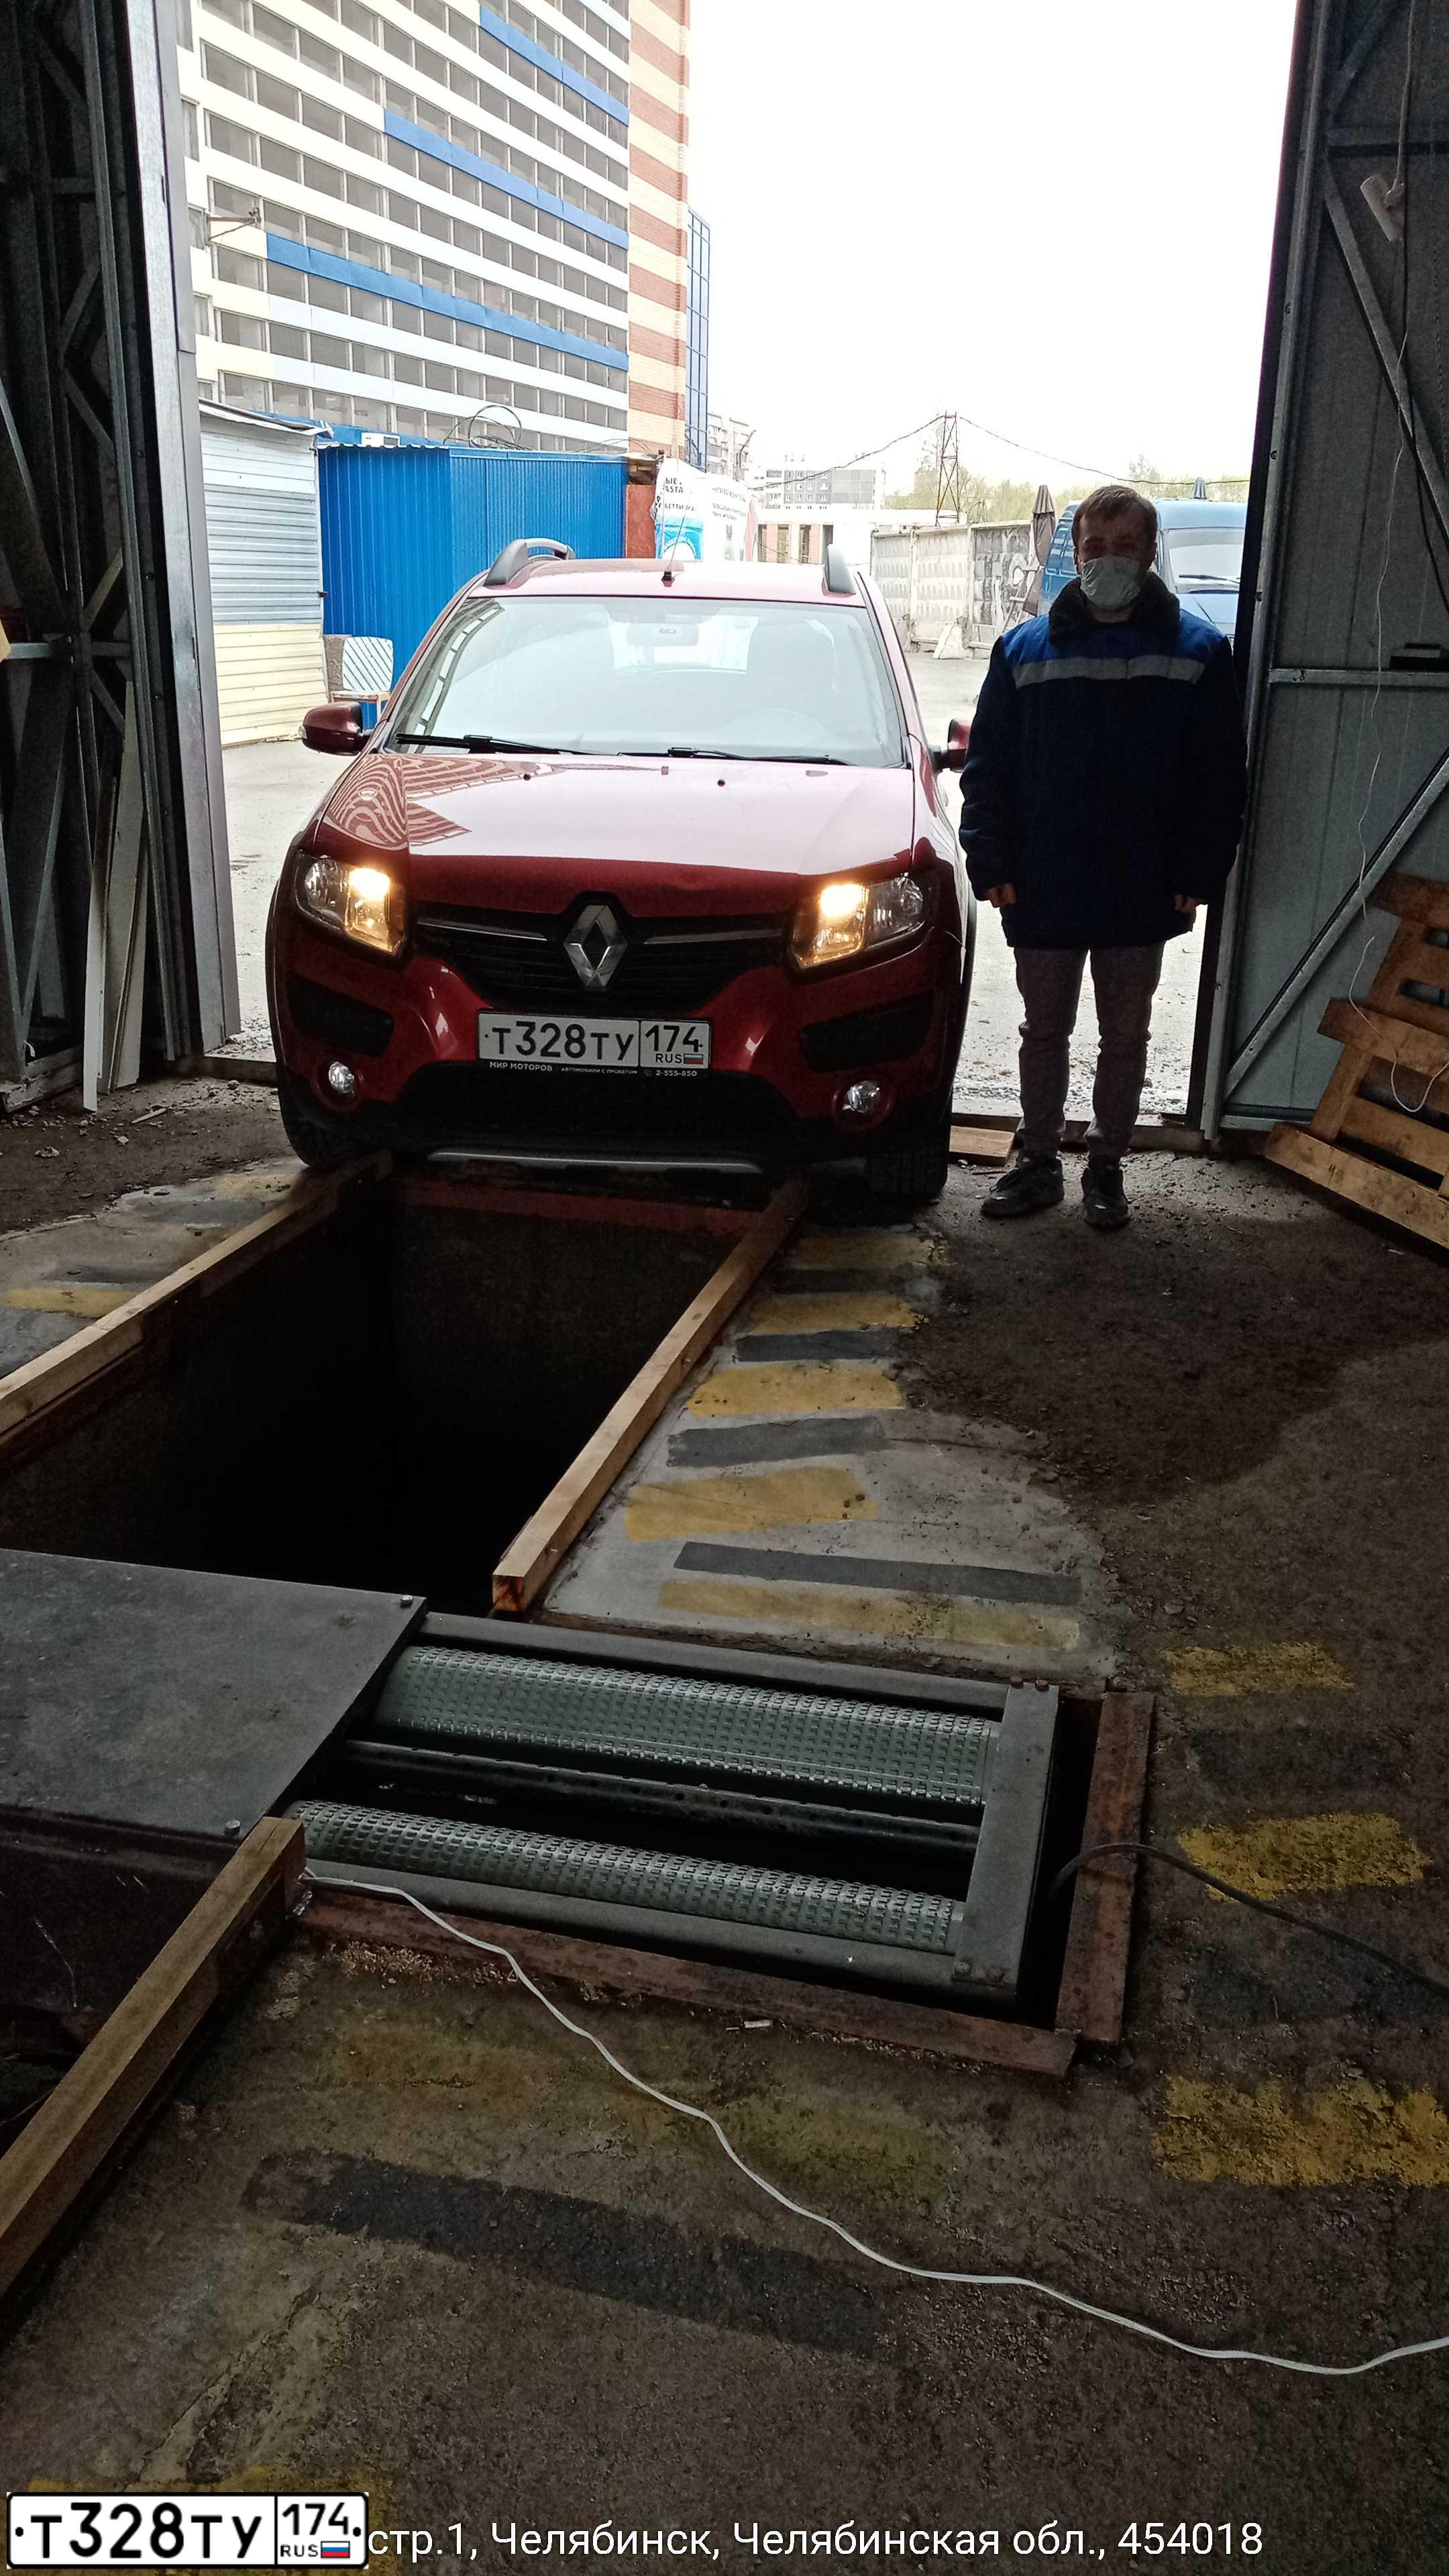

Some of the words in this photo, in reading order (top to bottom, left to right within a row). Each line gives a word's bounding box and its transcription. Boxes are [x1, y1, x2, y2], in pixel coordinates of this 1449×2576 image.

[491, 1020, 635, 1061] Т328ТУ
[643, 1024, 700, 1053] 174
[655, 1053, 682, 1064] RUS
[489, 1061, 508, 1069] МИР
[510, 1062, 553, 1071] МОТОРОВ
